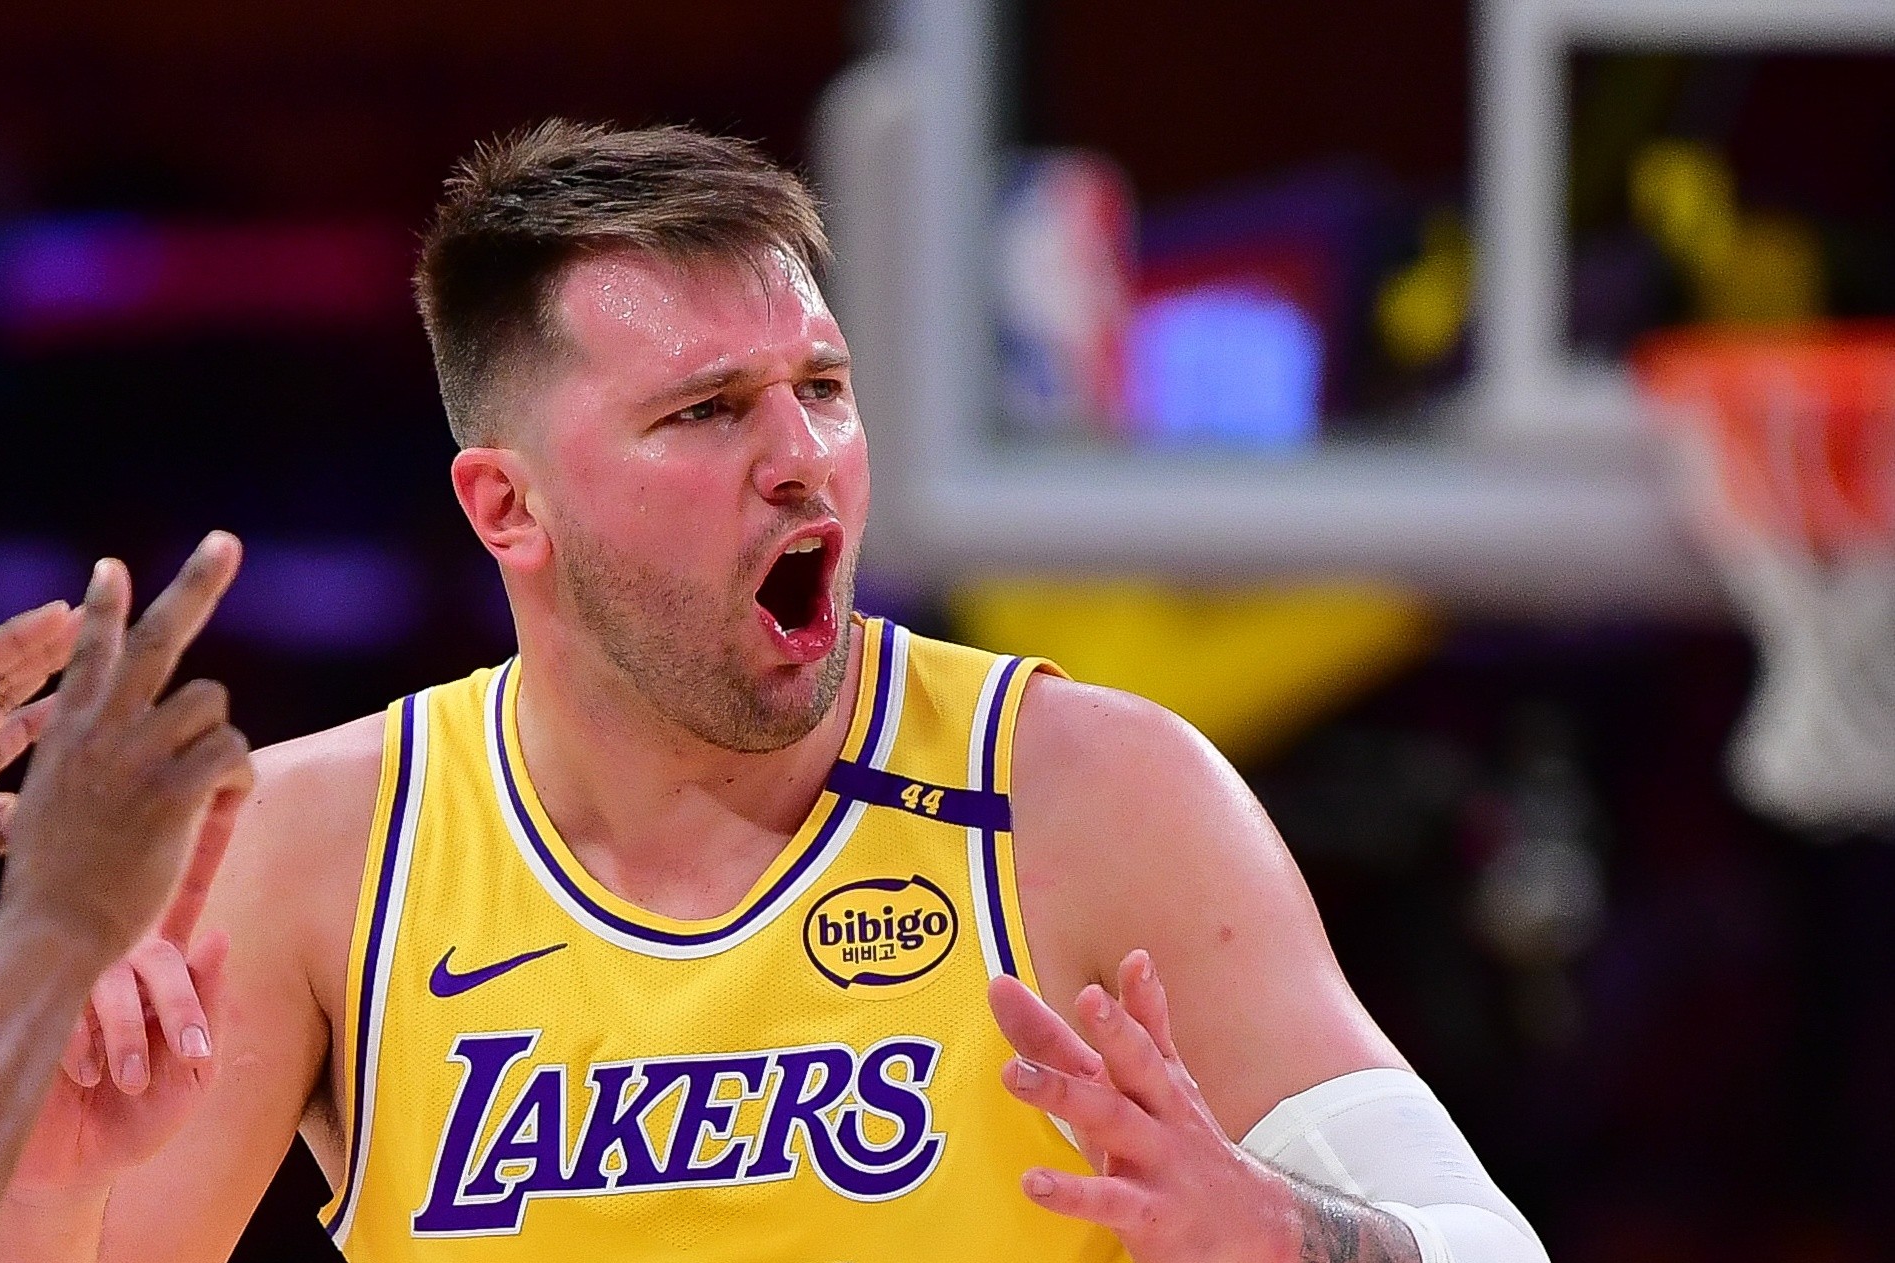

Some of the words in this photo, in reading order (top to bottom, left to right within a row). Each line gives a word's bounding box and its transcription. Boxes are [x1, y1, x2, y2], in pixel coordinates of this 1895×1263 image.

[901, 784, 944, 815] 44
[818, 905, 949, 950] bibigo
[842, 943, 897, 964] 비비고
[411, 1027, 945, 1237] LAKERS
